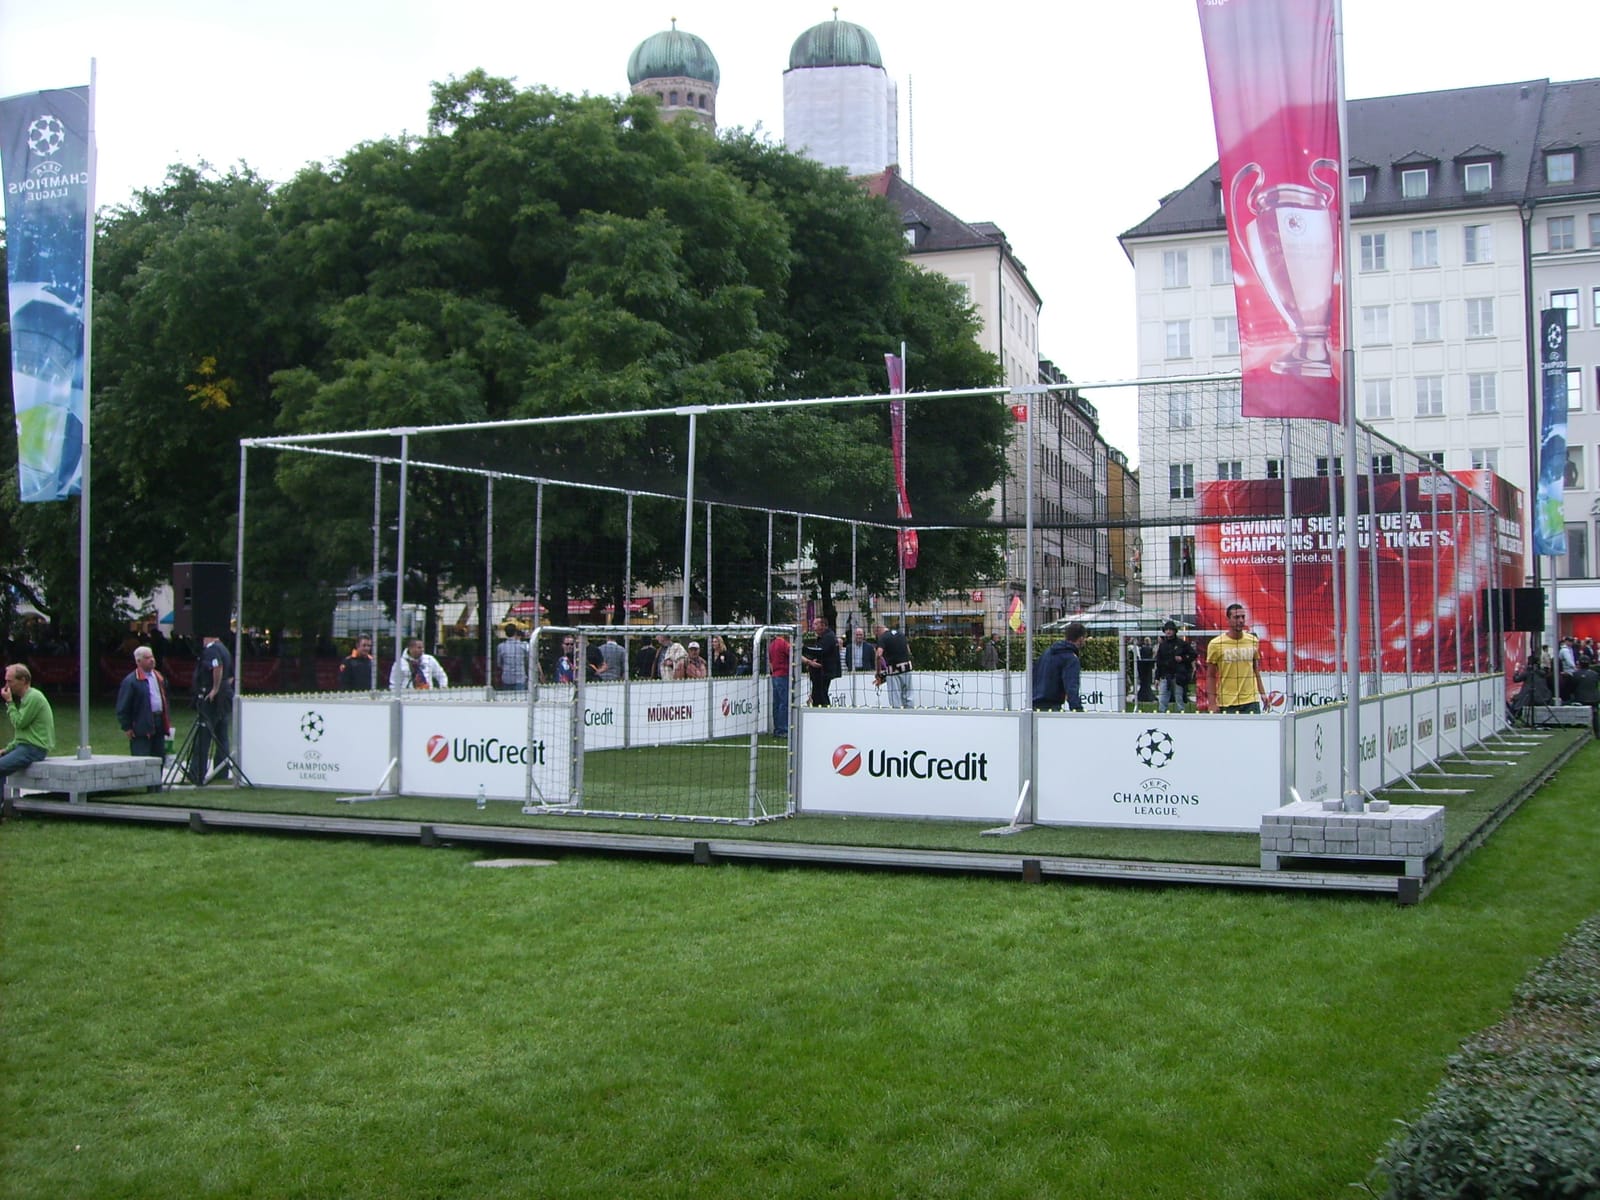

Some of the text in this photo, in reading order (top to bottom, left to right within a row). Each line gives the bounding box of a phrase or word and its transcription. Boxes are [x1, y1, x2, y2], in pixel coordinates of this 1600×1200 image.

[1220, 518, 1303, 535] GEWINNN
[648, 704, 692, 722] MÜNCHEN
[286, 761, 340, 772] CHAMPIONS
[868, 749, 988, 782] UniCredit
[299, 772, 327, 781] LEAGUE
[1142, 781, 1168, 790] UEFA
[1113, 792, 1200, 805] CHAMPIONS
[1134, 806, 1177, 816] LEAGUE
